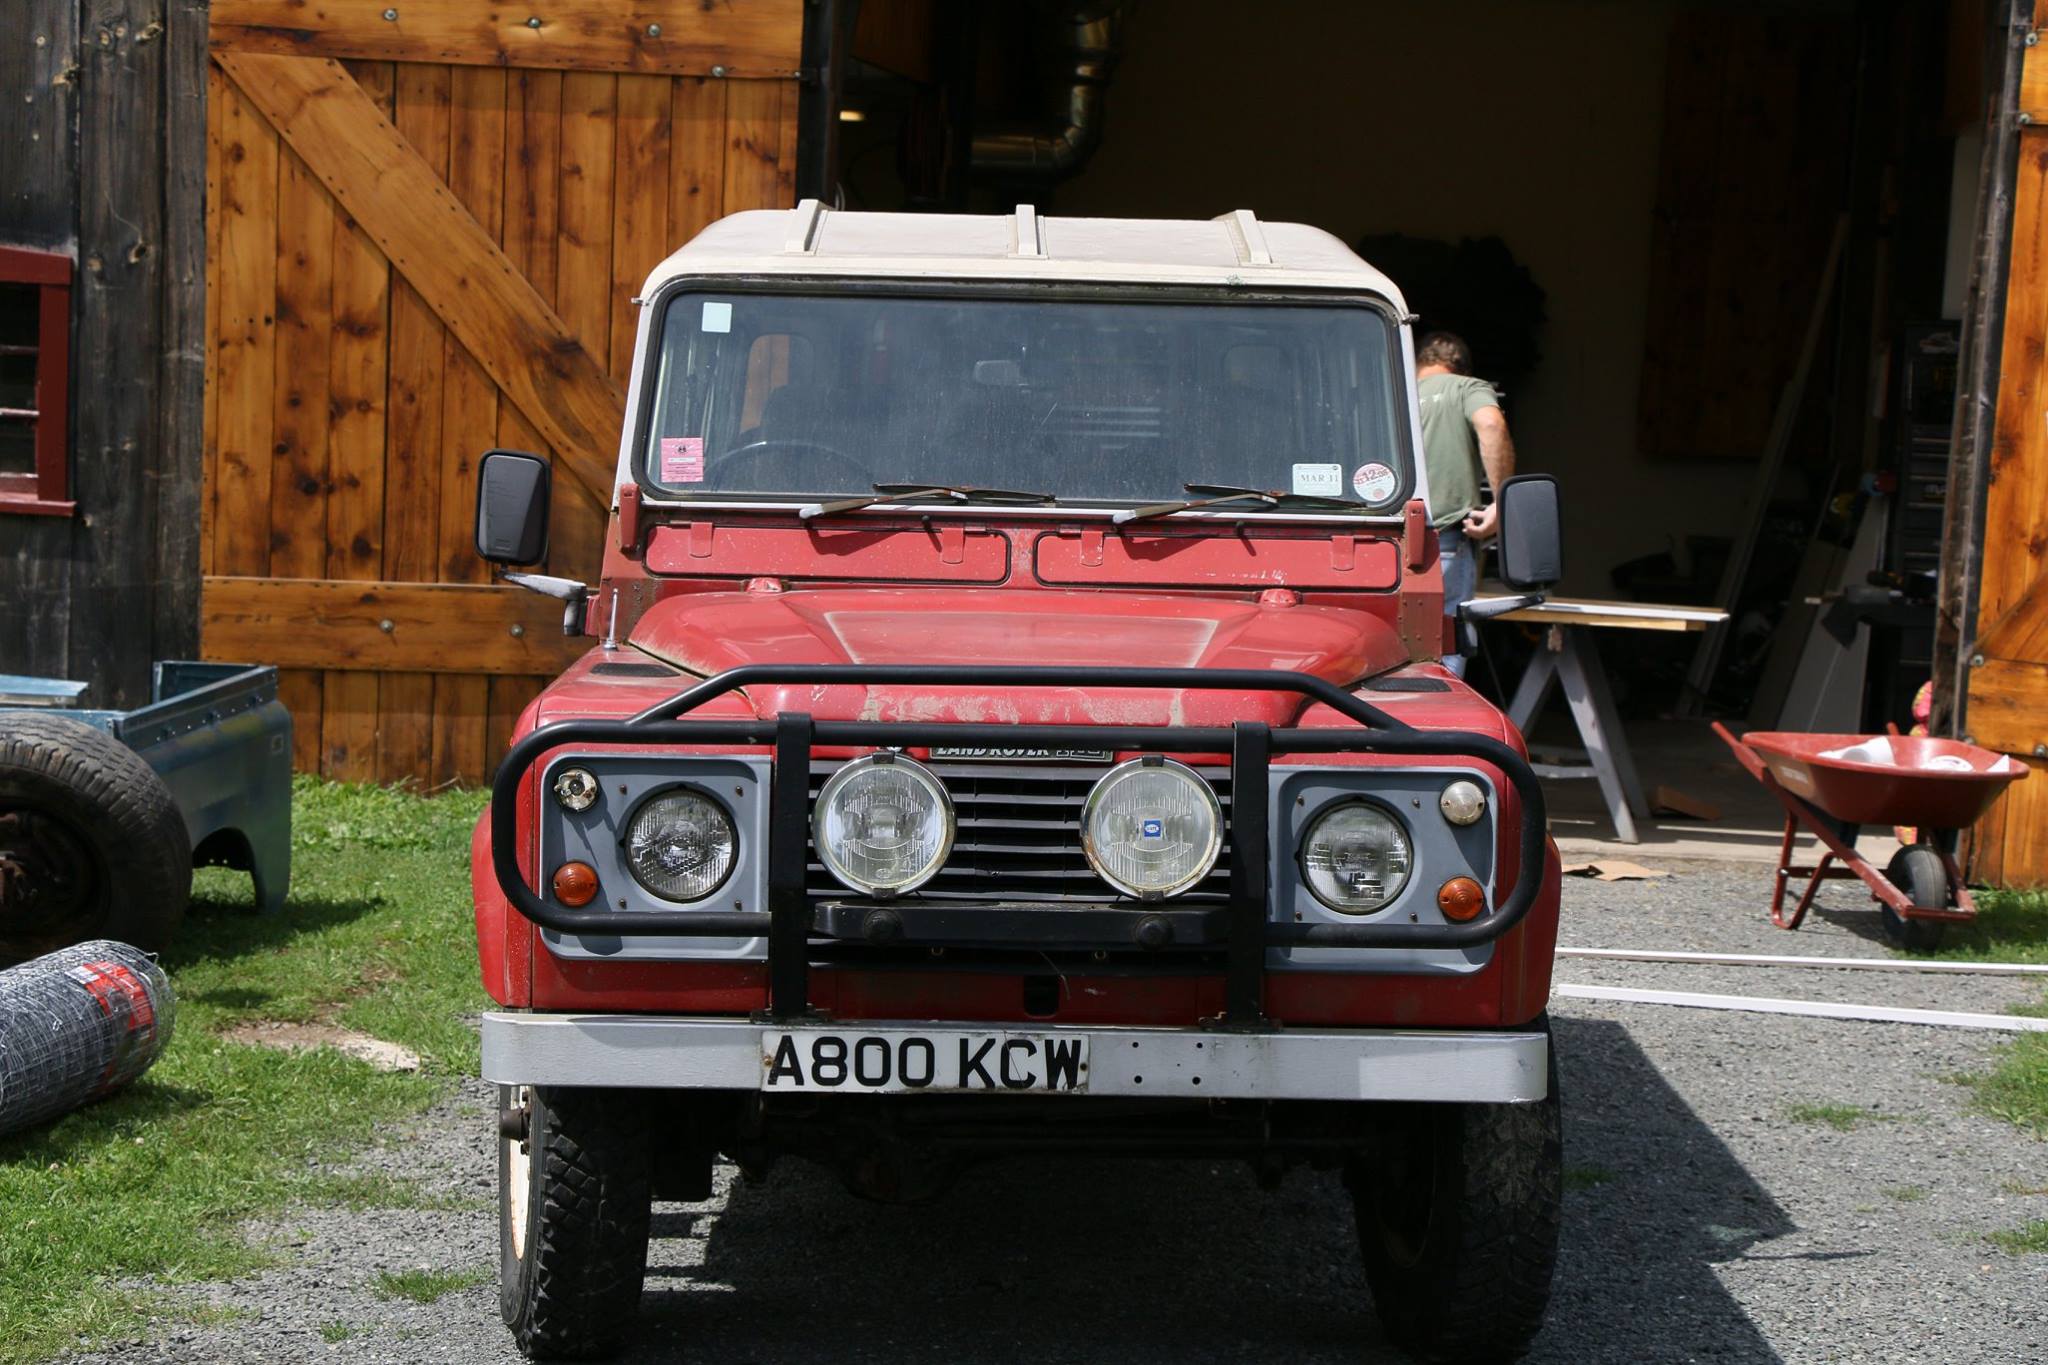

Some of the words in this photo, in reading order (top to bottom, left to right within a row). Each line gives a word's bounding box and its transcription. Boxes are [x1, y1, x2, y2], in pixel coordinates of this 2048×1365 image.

[1300, 474, 1325, 482] MAR
[767, 1034, 936, 1088] A800
[958, 1037, 1082, 1090] KCW
